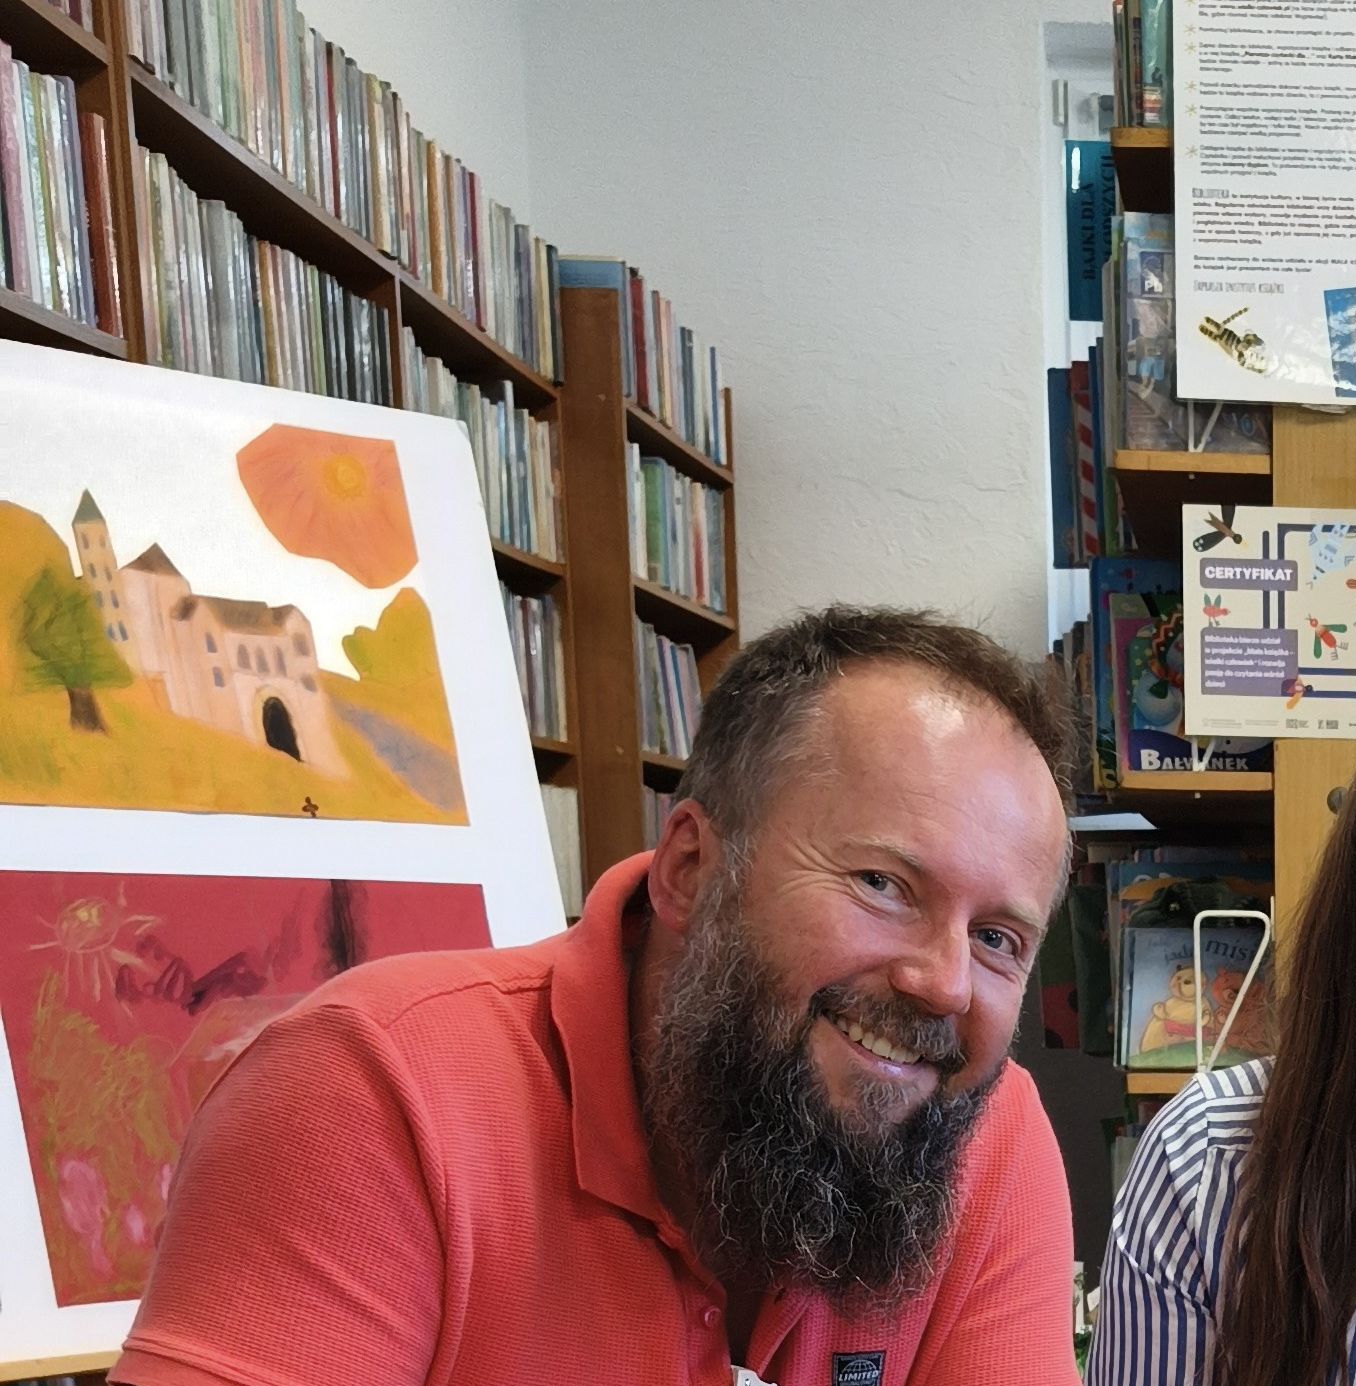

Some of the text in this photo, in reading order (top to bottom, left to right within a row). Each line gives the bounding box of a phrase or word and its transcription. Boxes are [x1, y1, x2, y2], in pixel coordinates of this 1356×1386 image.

[1080, 183, 1095, 219] DLA
[1204, 566, 1293, 581] CERTYFIKAT
[838, 1370, 879, 1382] LIMITED
